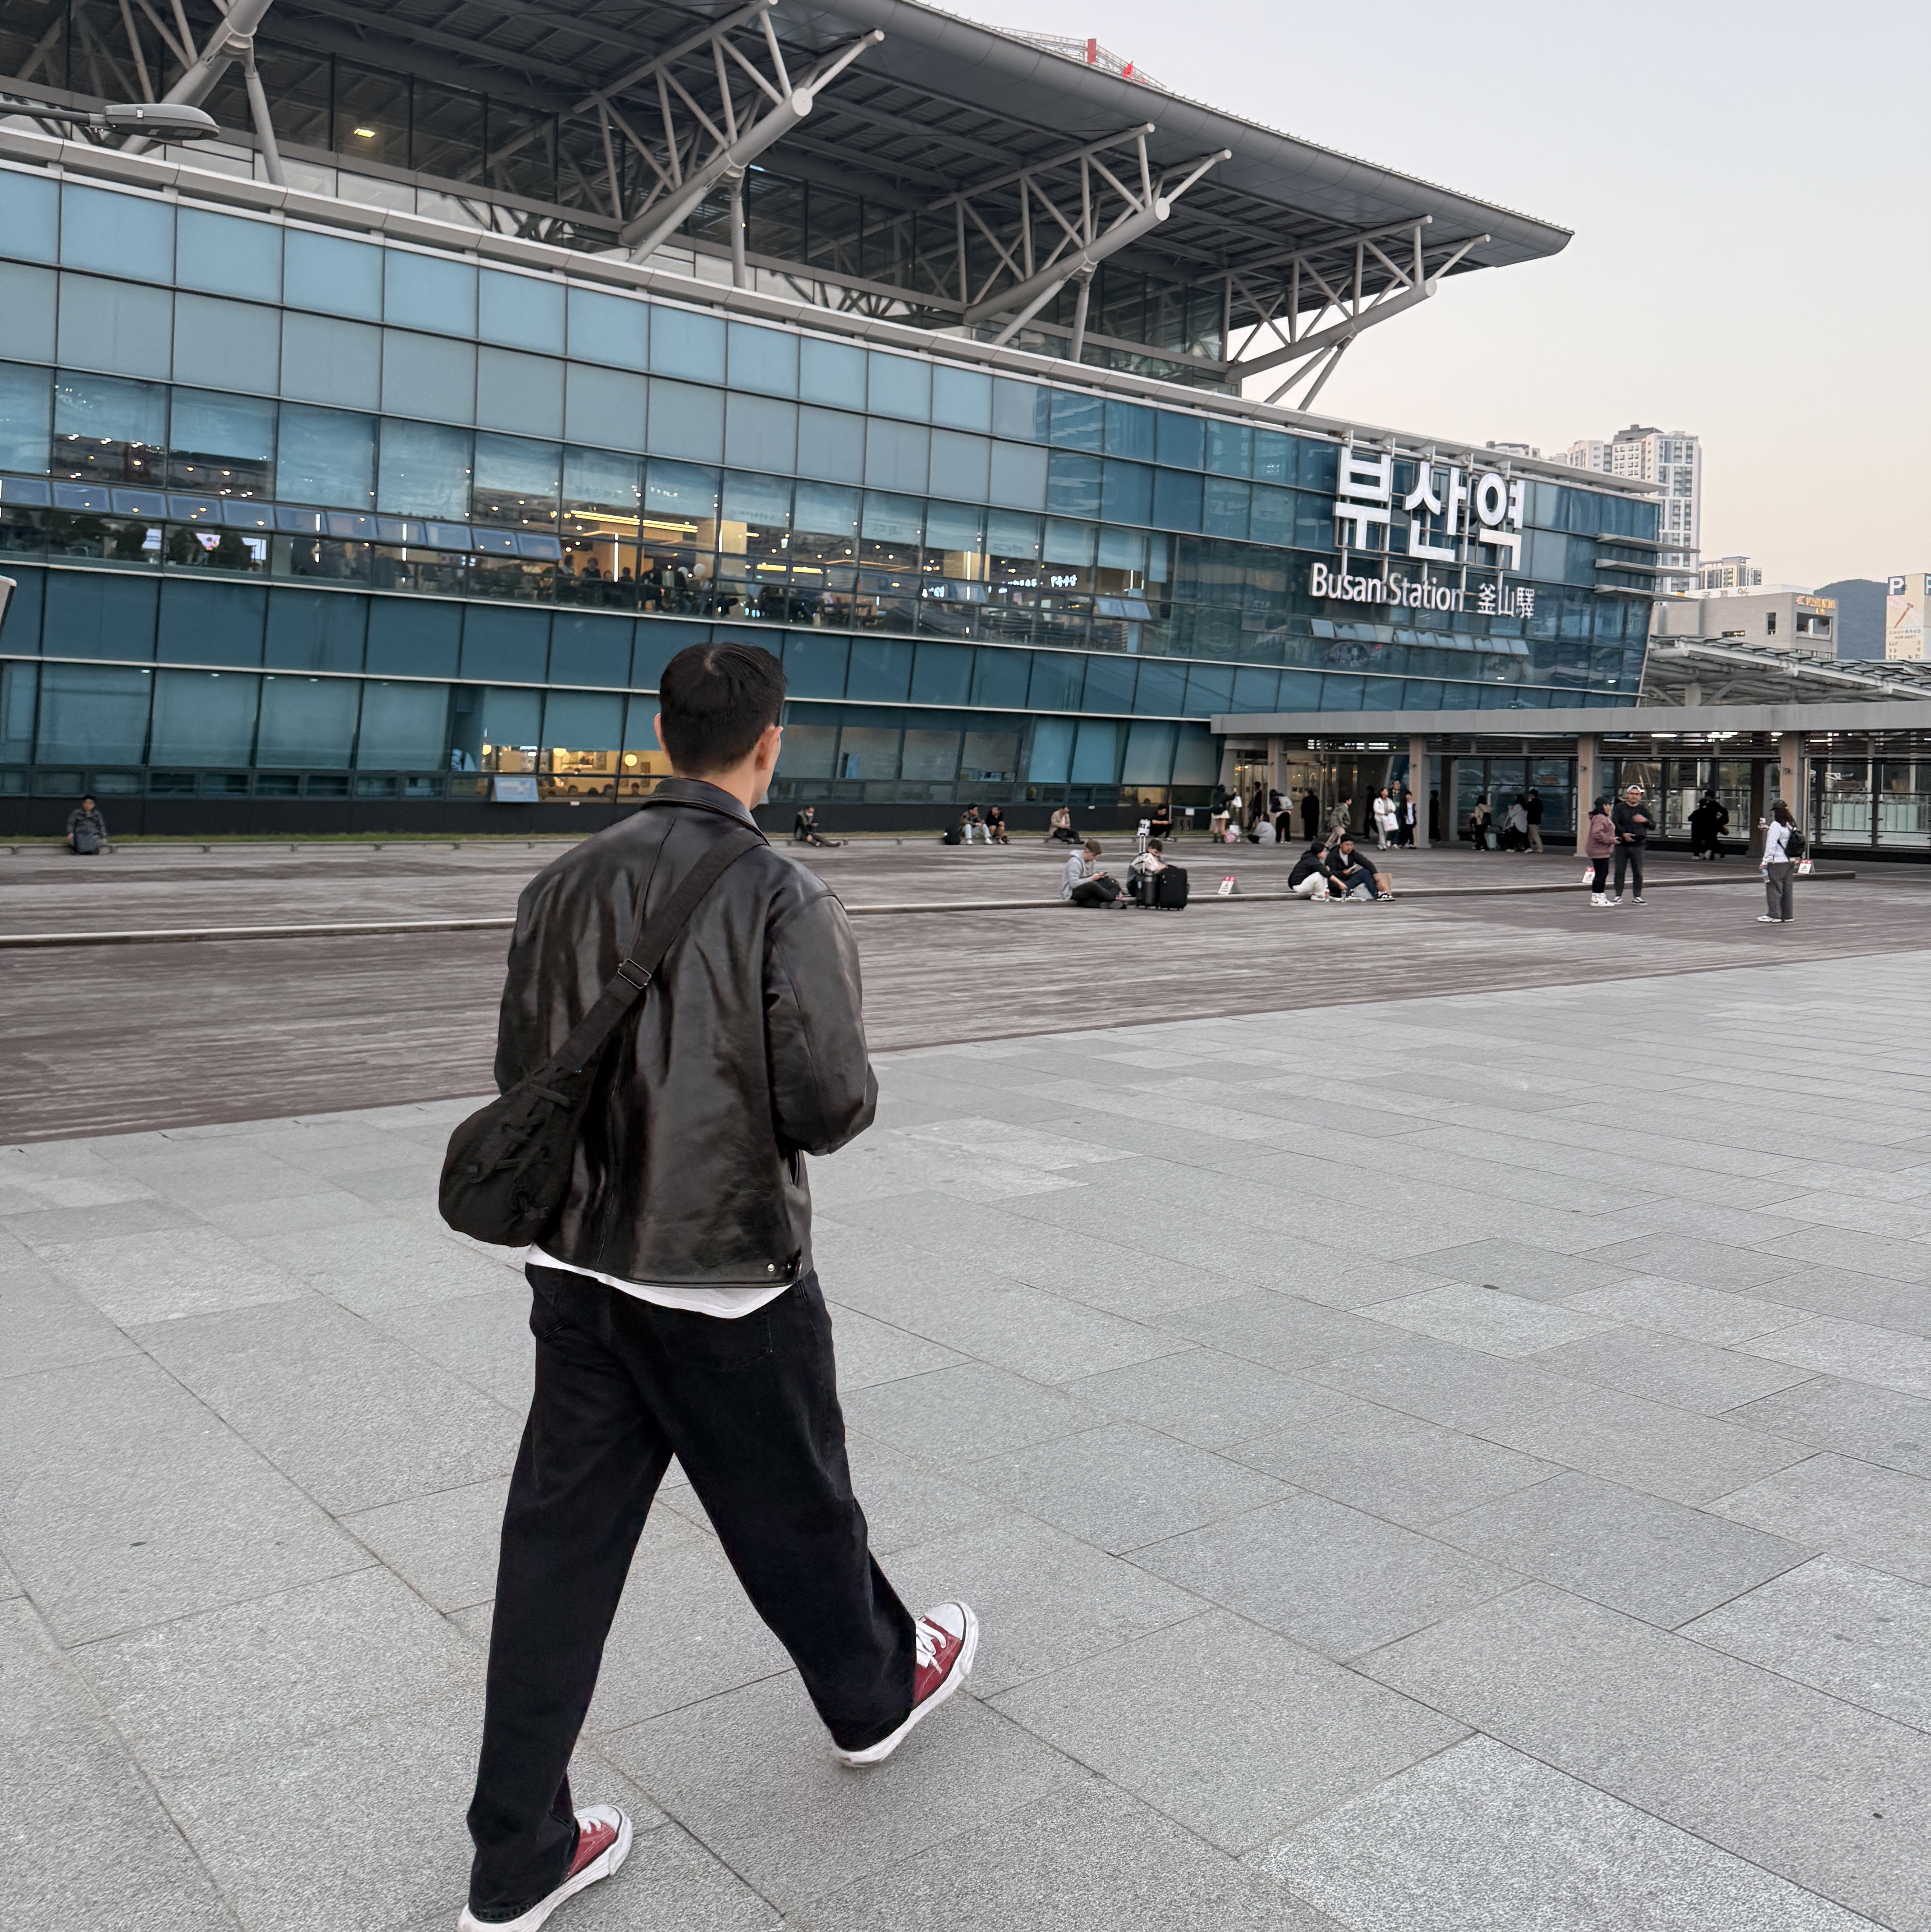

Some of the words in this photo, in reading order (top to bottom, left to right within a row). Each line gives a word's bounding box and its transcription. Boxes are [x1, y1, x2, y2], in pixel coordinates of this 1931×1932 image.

[1333, 446, 1525, 571] 부산역
[1310, 562, 1381, 603] Busan
[1389, 572, 1464, 612] Station
[1477, 583, 1535, 619] 釜山驛
[1889, 577, 1904, 595] P
